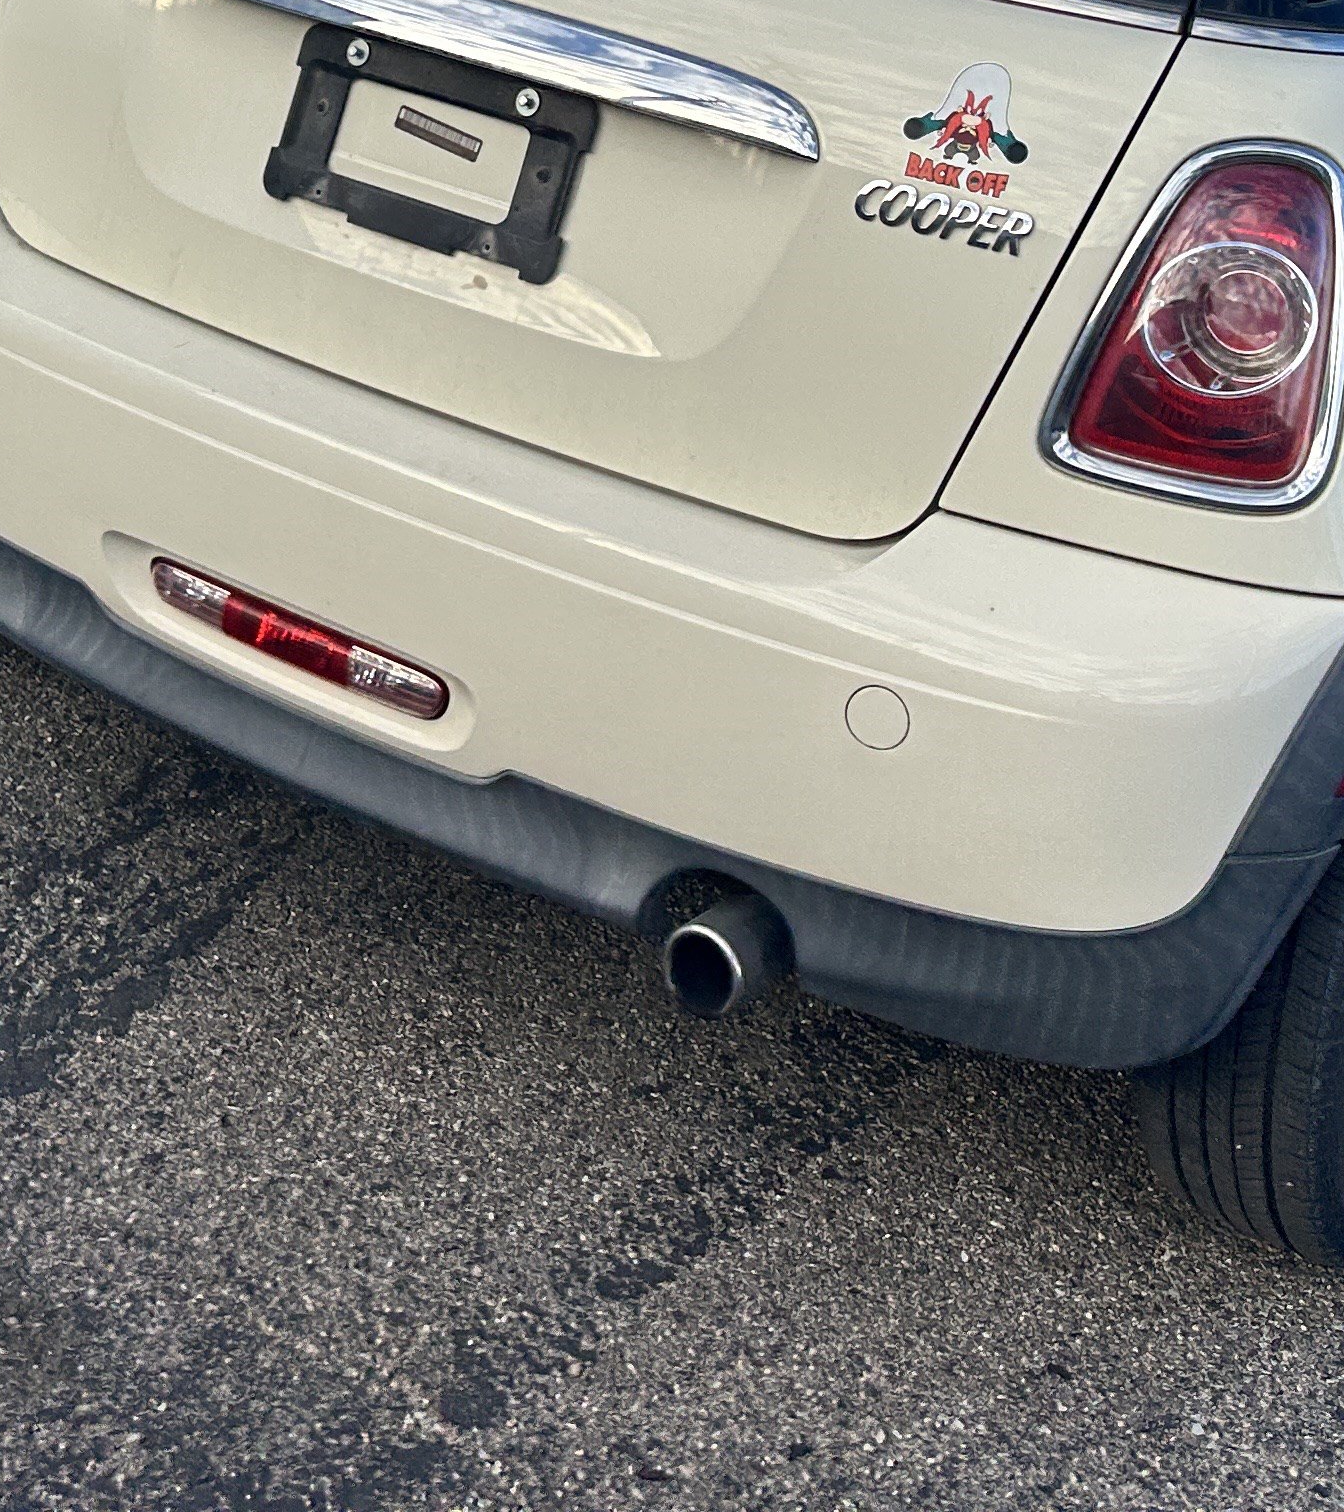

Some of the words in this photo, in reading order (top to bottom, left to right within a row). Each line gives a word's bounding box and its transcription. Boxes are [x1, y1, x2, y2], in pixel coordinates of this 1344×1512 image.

[905, 151, 965, 189] BACK
[965, 169, 1010, 198] OFF
[853, 178, 1035, 257] COOPER
